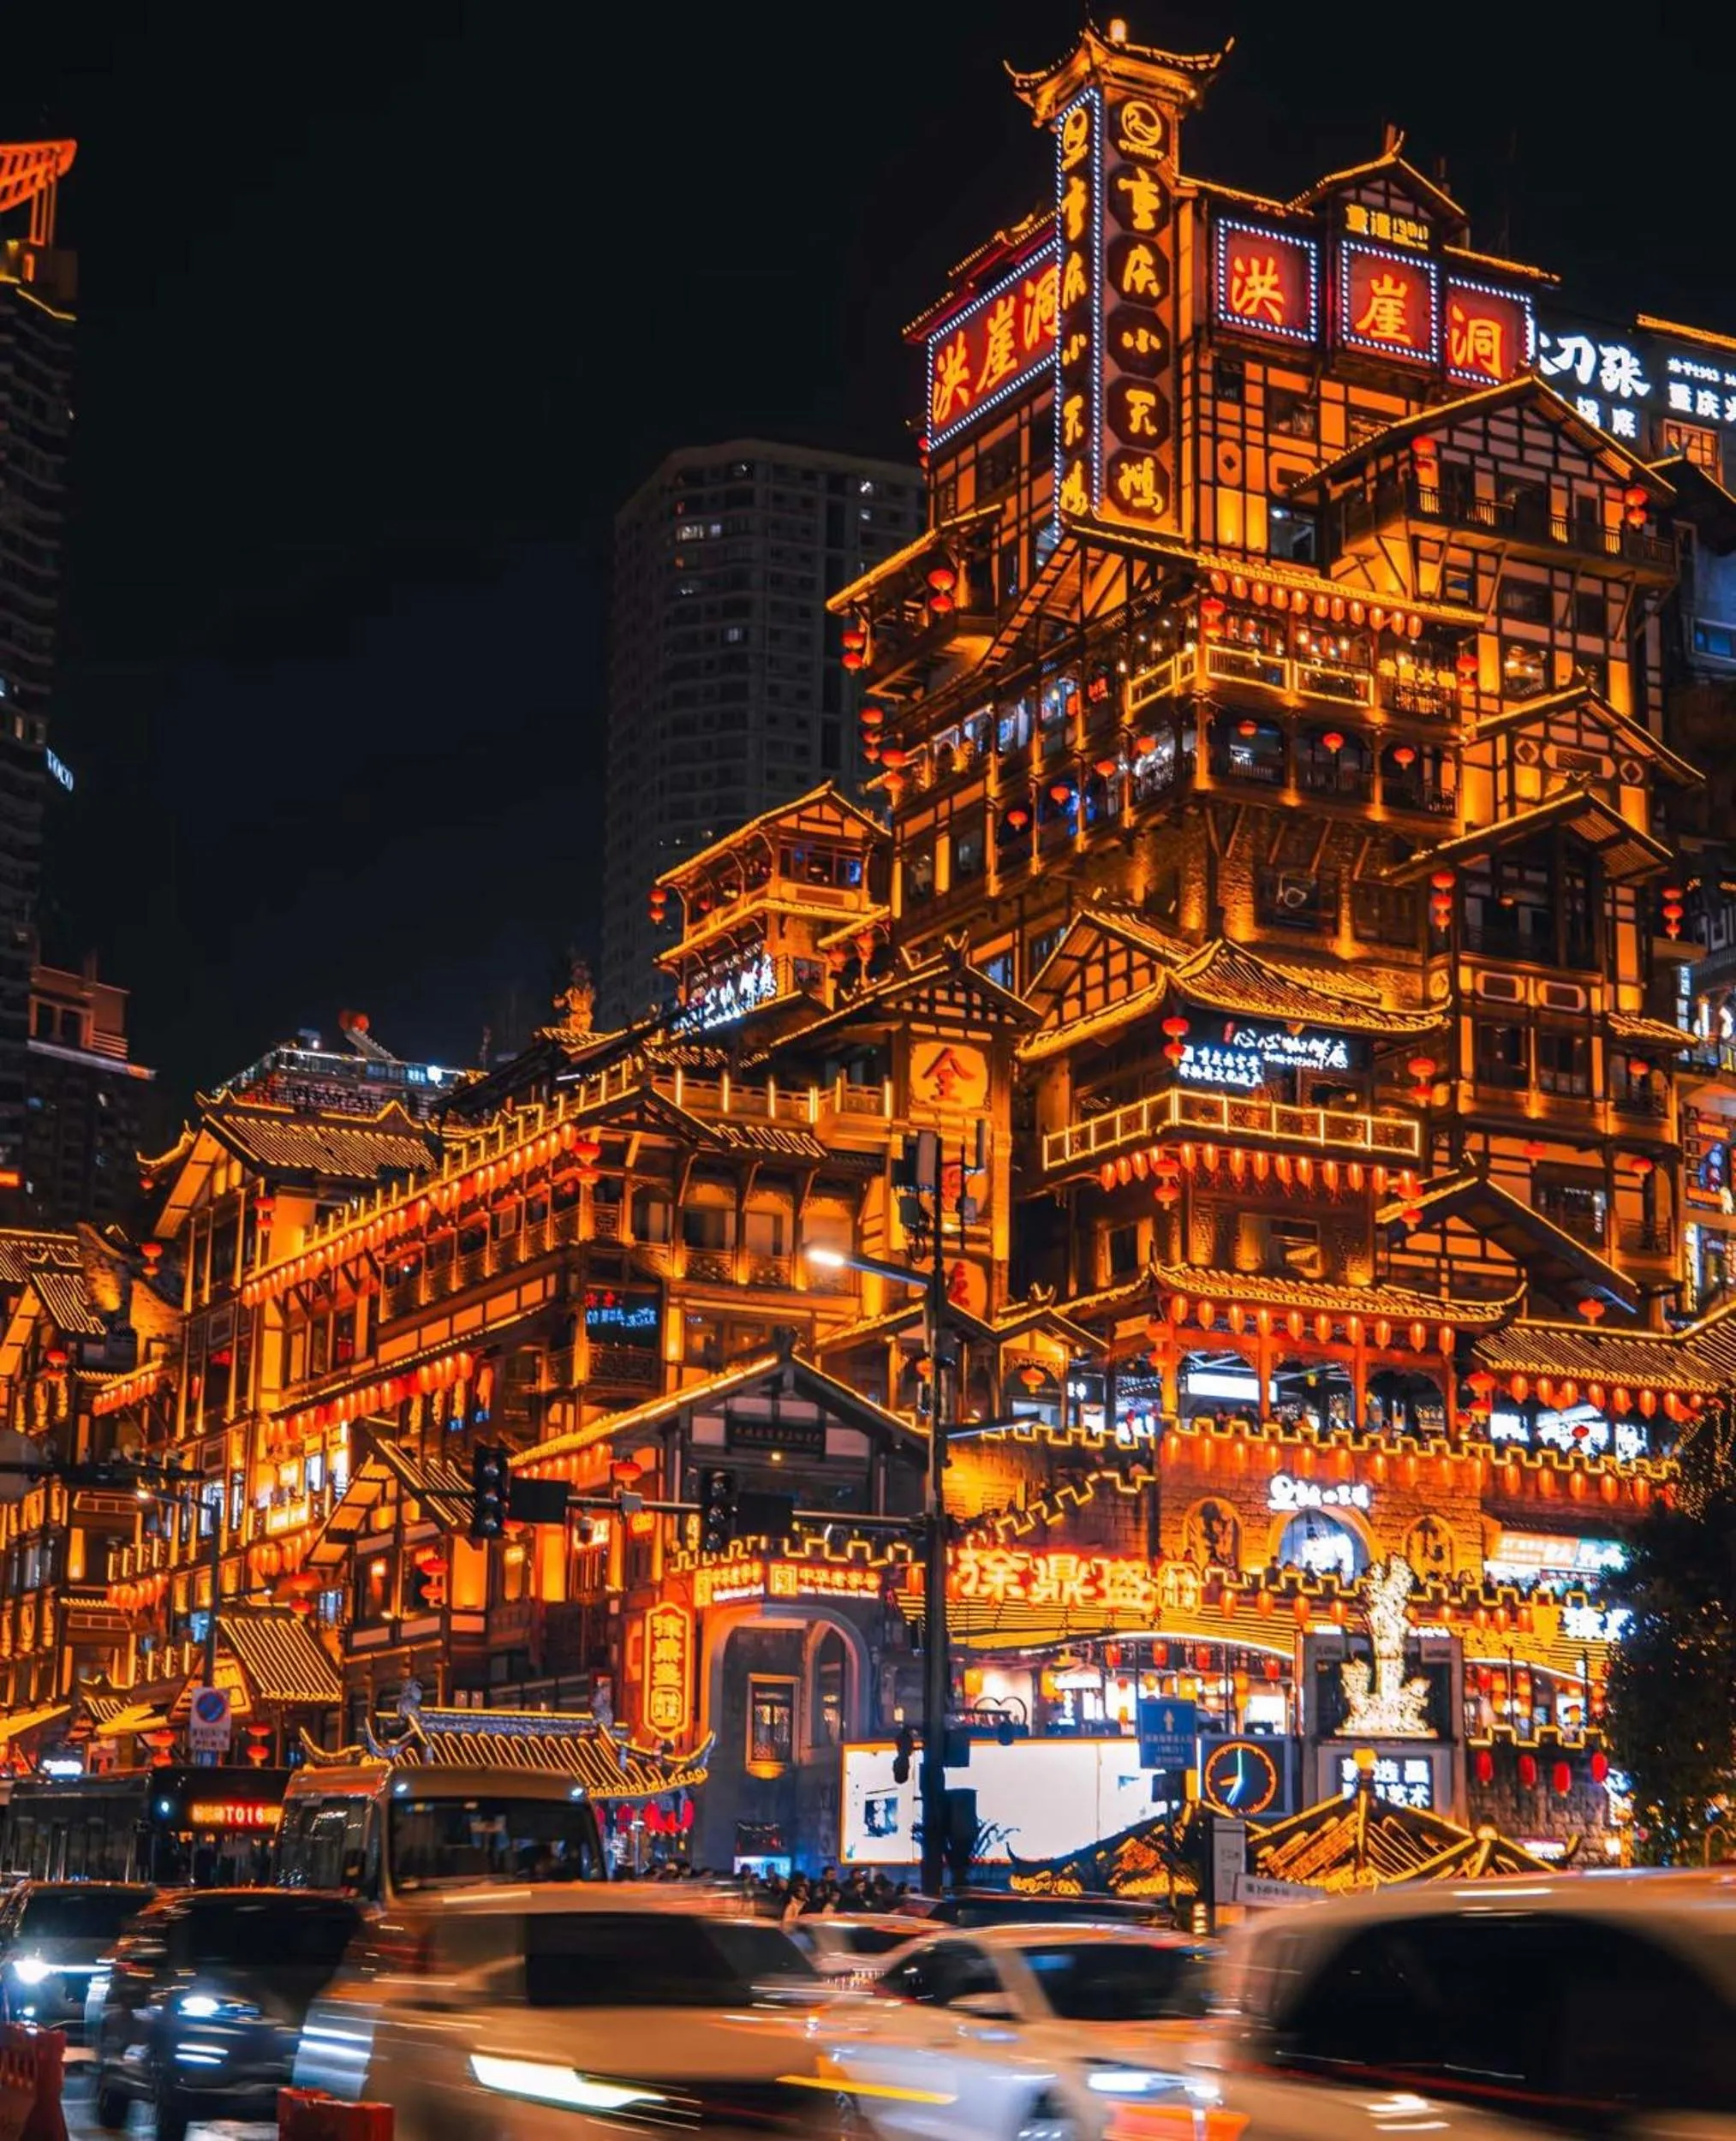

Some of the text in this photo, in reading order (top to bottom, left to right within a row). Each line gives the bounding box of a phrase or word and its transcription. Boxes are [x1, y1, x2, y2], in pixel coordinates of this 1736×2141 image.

[932, 265, 1059, 426] 洪崖洞
[1231, 255, 1504, 378] 洪崖洞
